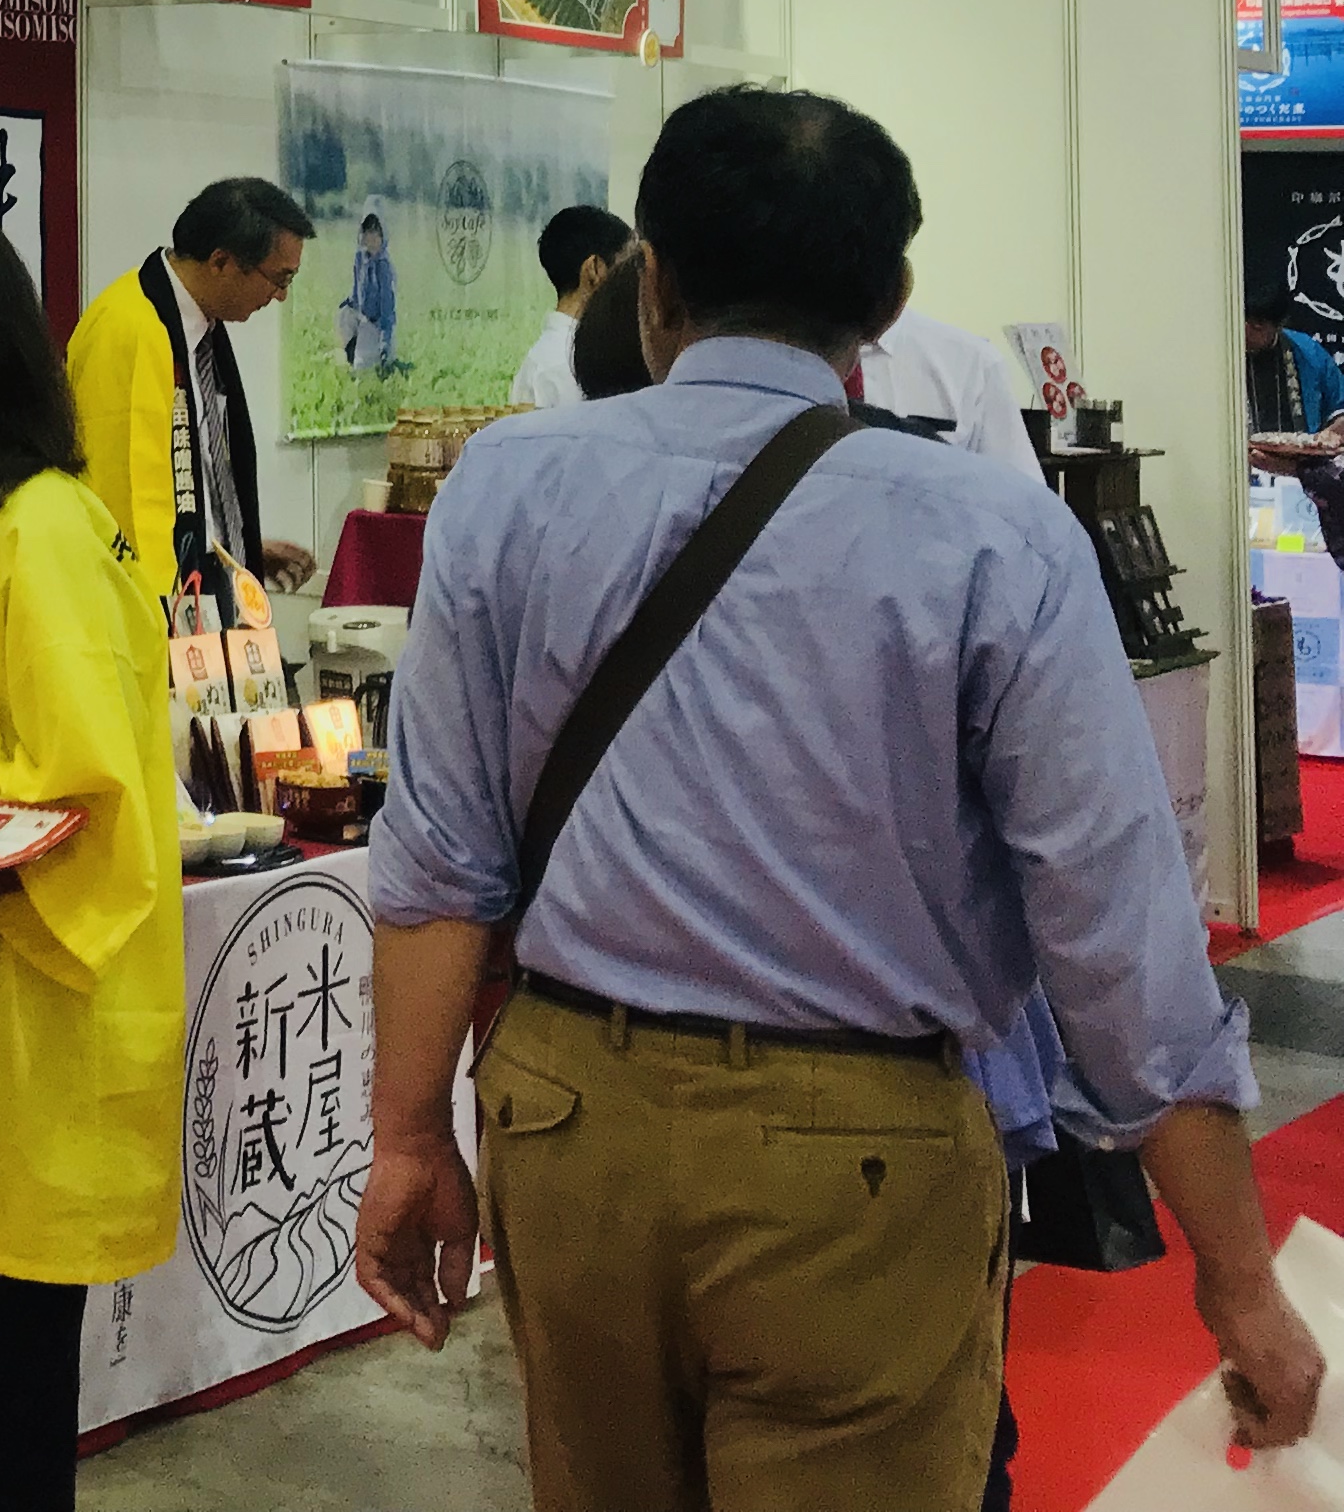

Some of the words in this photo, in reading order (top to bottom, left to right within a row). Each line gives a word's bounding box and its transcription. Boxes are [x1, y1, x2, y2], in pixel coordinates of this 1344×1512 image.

[247, 906, 347, 966] SHINGURA
[230, 973, 296, 1196] 新蔵
[296, 942, 353, 1159] 米屋
